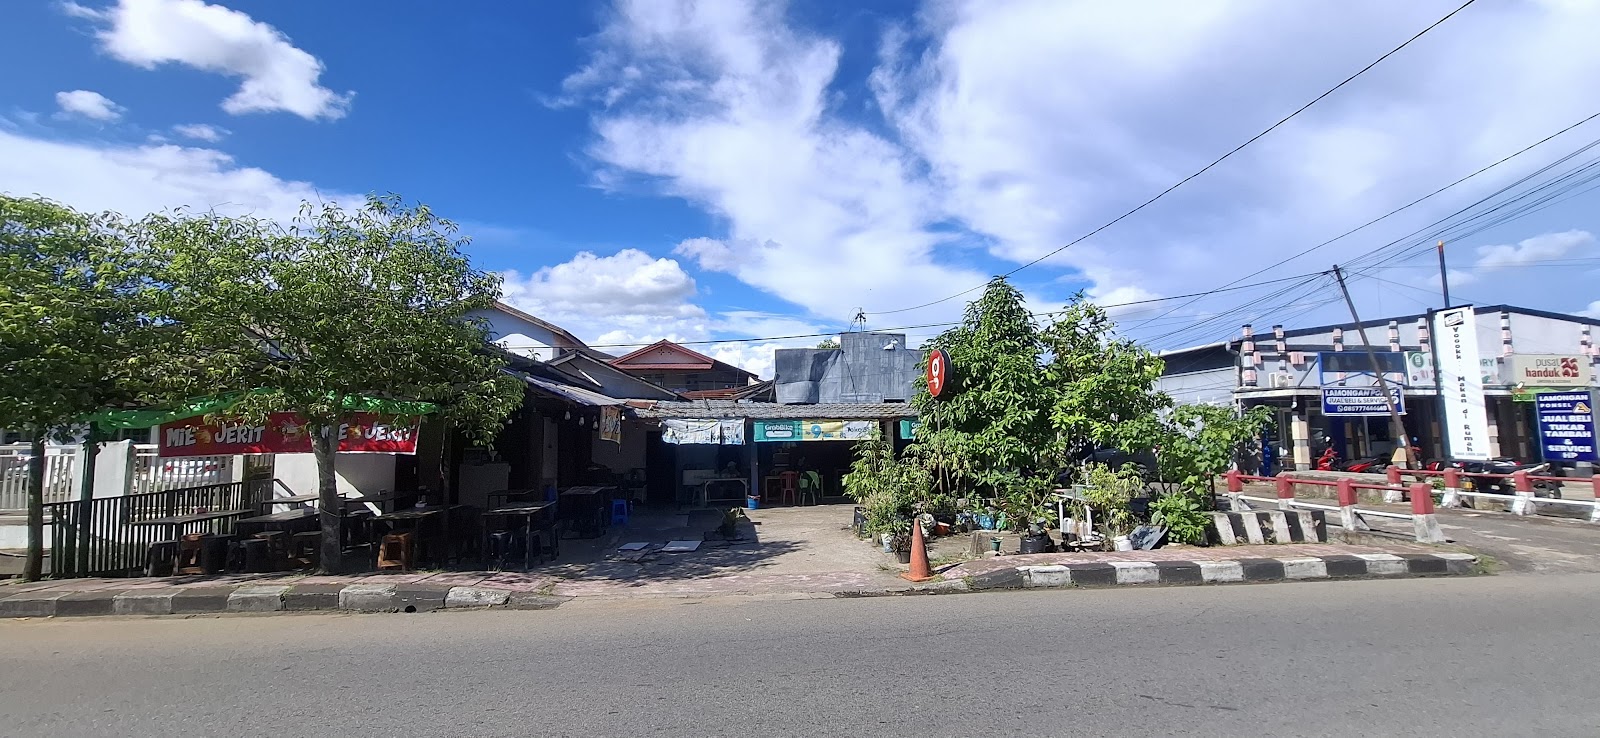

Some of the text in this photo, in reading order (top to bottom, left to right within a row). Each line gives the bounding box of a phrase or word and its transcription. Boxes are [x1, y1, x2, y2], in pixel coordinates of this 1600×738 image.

[1536, 358, 1560, 369] pusat
[1525, 367, 1560, 377] handuk
[1325, 389, 1370, 397] LAMONGAN
